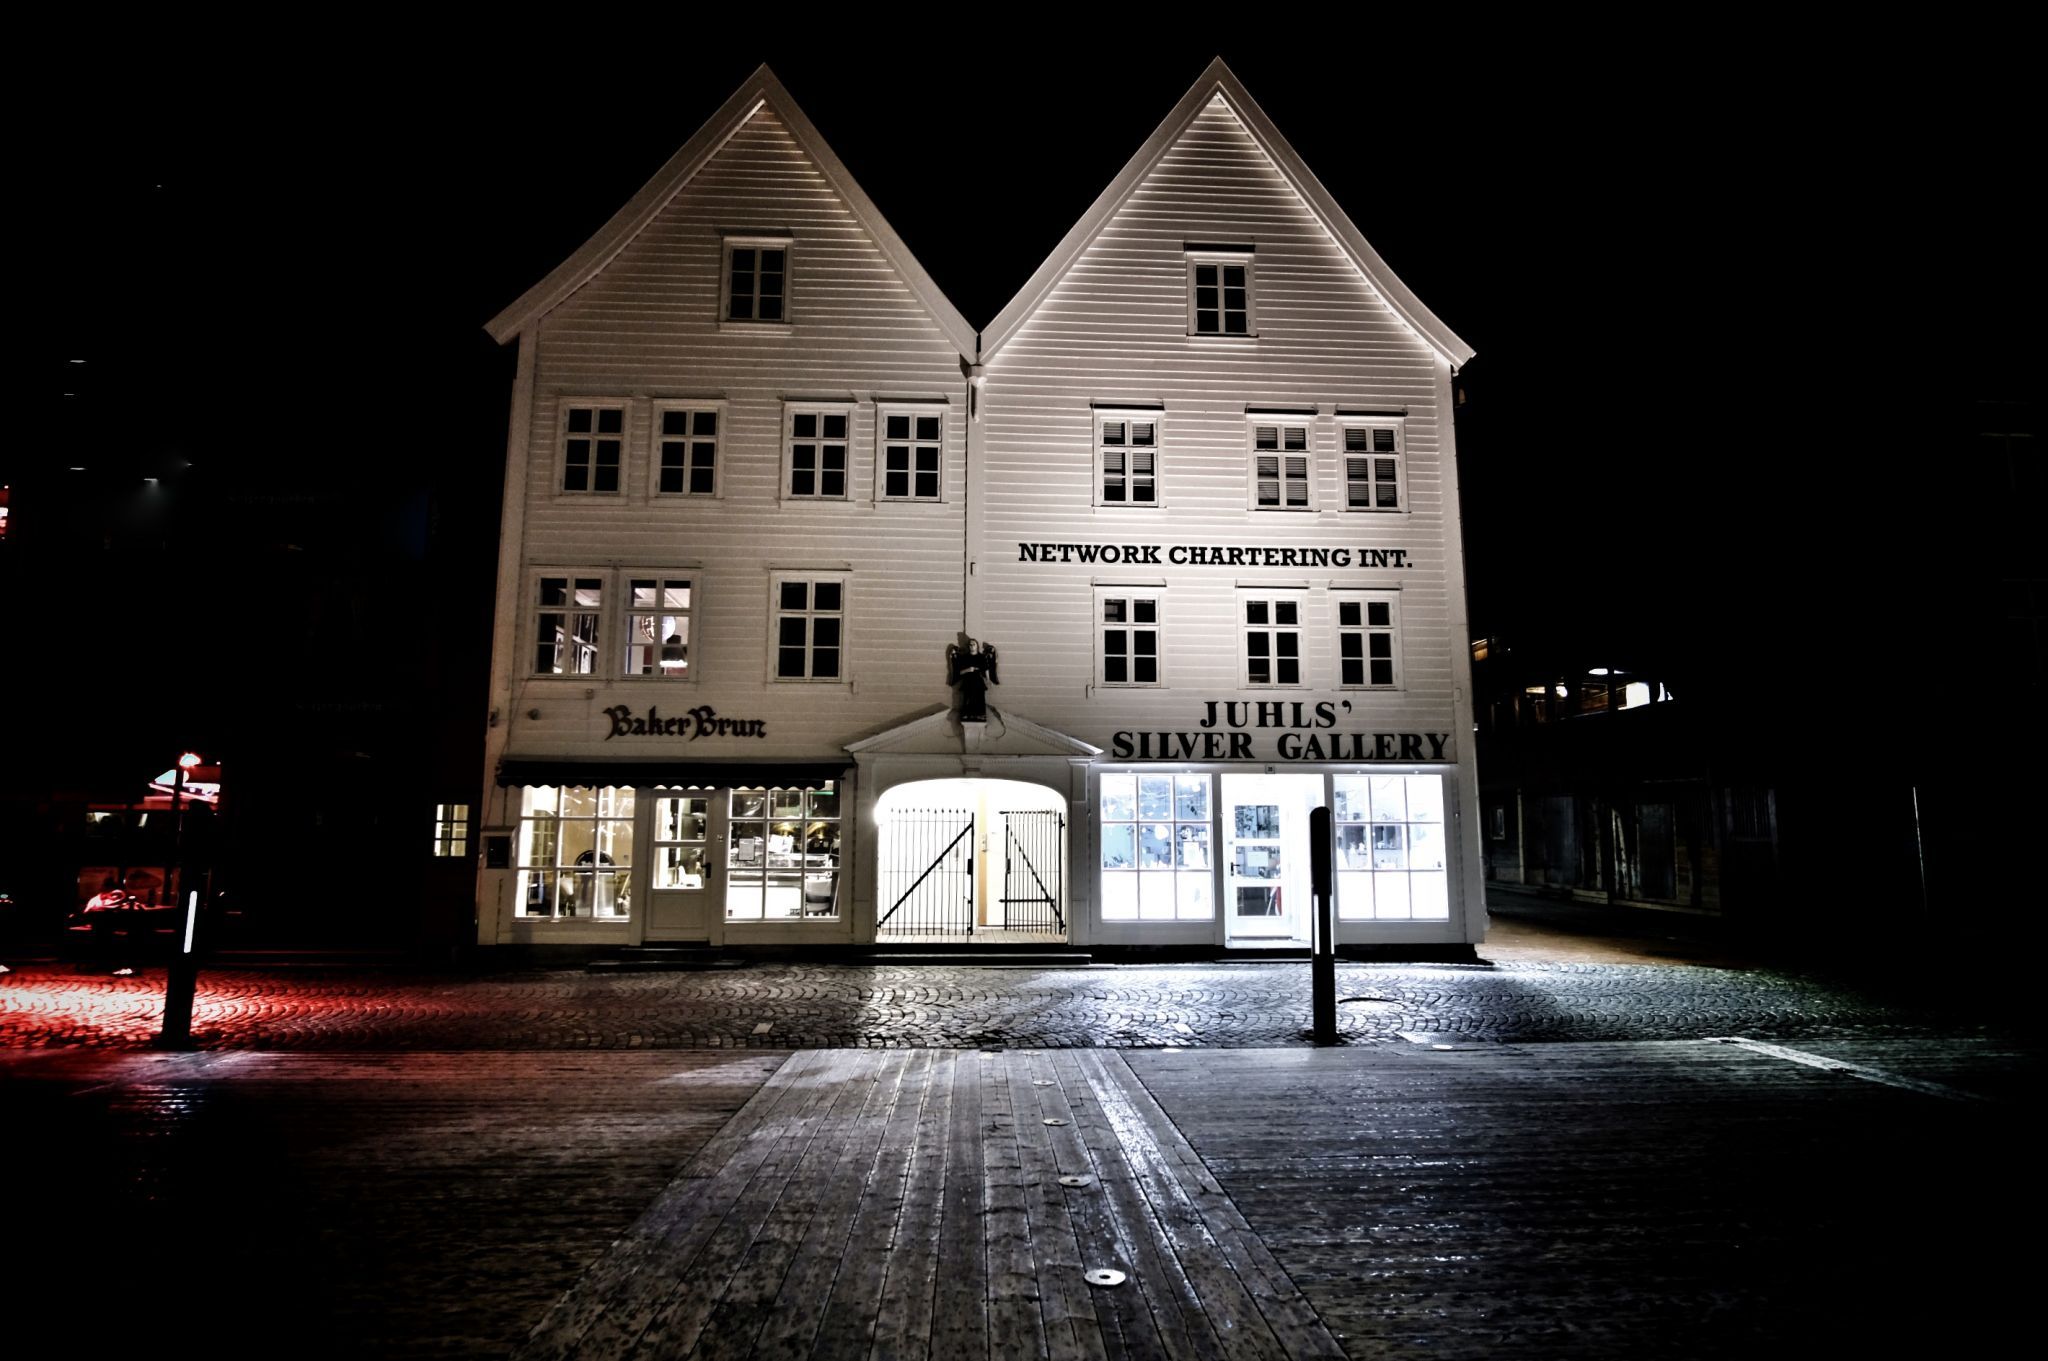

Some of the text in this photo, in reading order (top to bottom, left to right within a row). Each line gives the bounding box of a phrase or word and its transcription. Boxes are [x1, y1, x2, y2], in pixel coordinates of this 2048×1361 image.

[1018, 543, 1413, 568] NETWORK CHARTERING INT.
[1111, 731, 1450, 761] SILVER GALLERY
